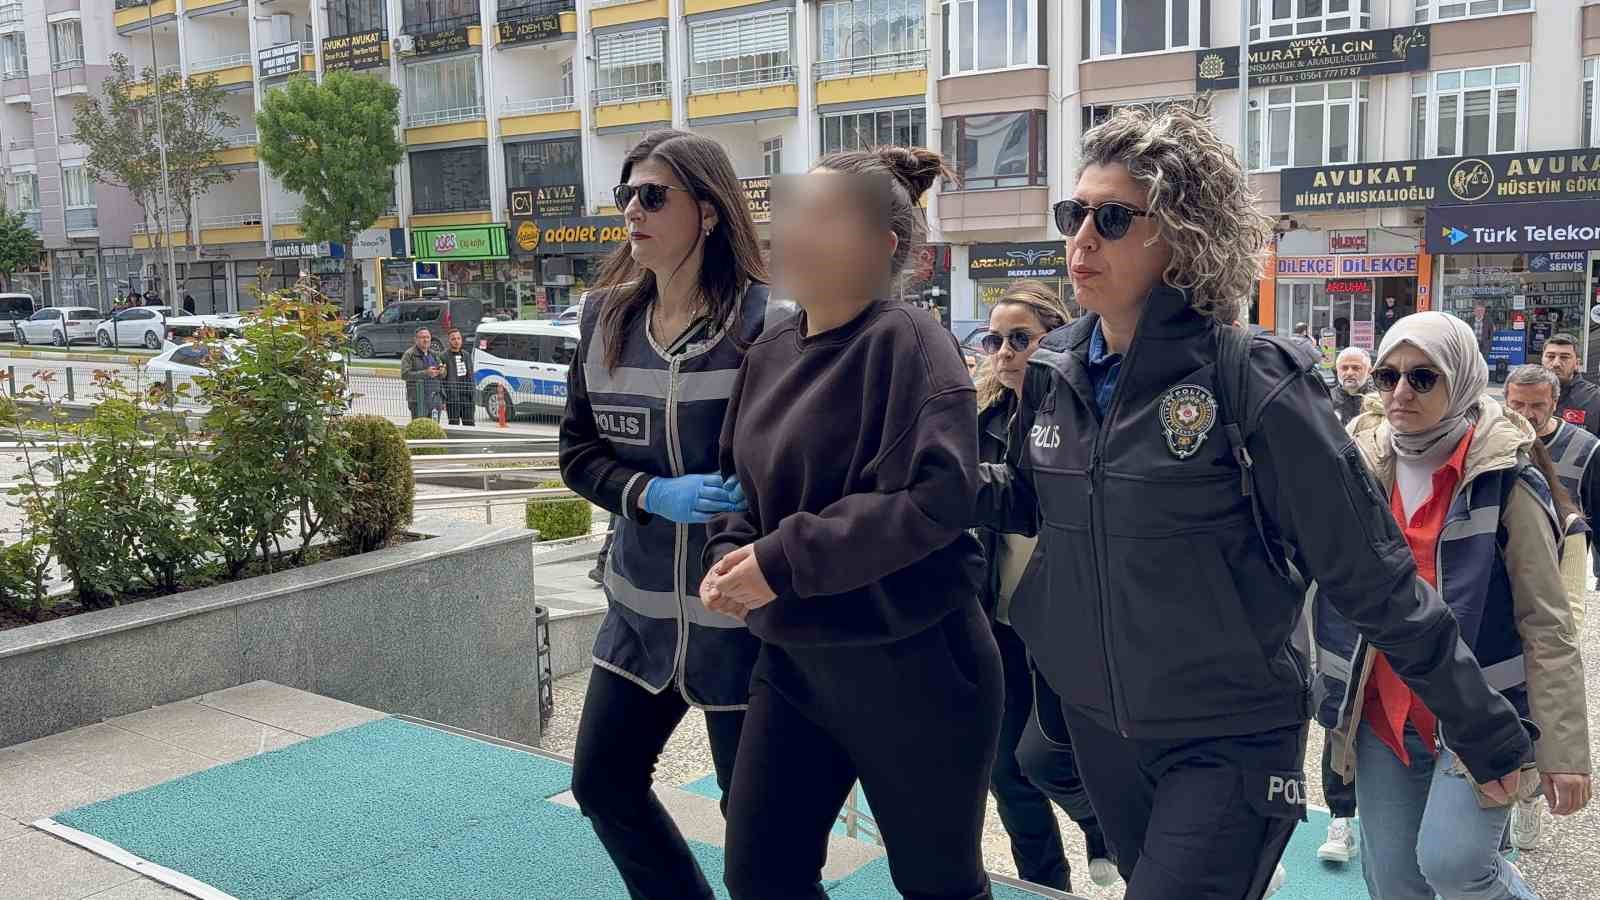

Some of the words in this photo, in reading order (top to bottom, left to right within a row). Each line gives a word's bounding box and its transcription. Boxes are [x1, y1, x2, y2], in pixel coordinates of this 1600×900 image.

[323, 38, 350, 50] AVUKAT
[351, 32, 379, 45] AVUKAT
[1289, 37, 1328, 48] AVUKAT
[1247, 47, 1304, 63] MURAT
[1309, 39, 1374, 57] YALÇIN
[1313, 166, 1417, 187] AVUKAT
[537, 185, 576, 200] AYVAZ
[1497, 177, 1561, 196] HÜSEYİN
[1295, 191, 1334, 206] NİHAT
[1337, 185, 1435, 204] AHISKALIOĞLU
[545, 225, 597, 243] adalet
[1331, 233, 1366, 250] DİLEKÇE
[1473, 225, 1518, 243] Türk
[274, 243, 300, 256] KUAFÖR
[970, 258, 1024, 268] ARZUHAL
[1278, 259, 1334, 275] DİLEKÇE
[1342, 257, 1417, 273] DİLEKÇE
[1550, 262, 1584, 272] SERVİS
